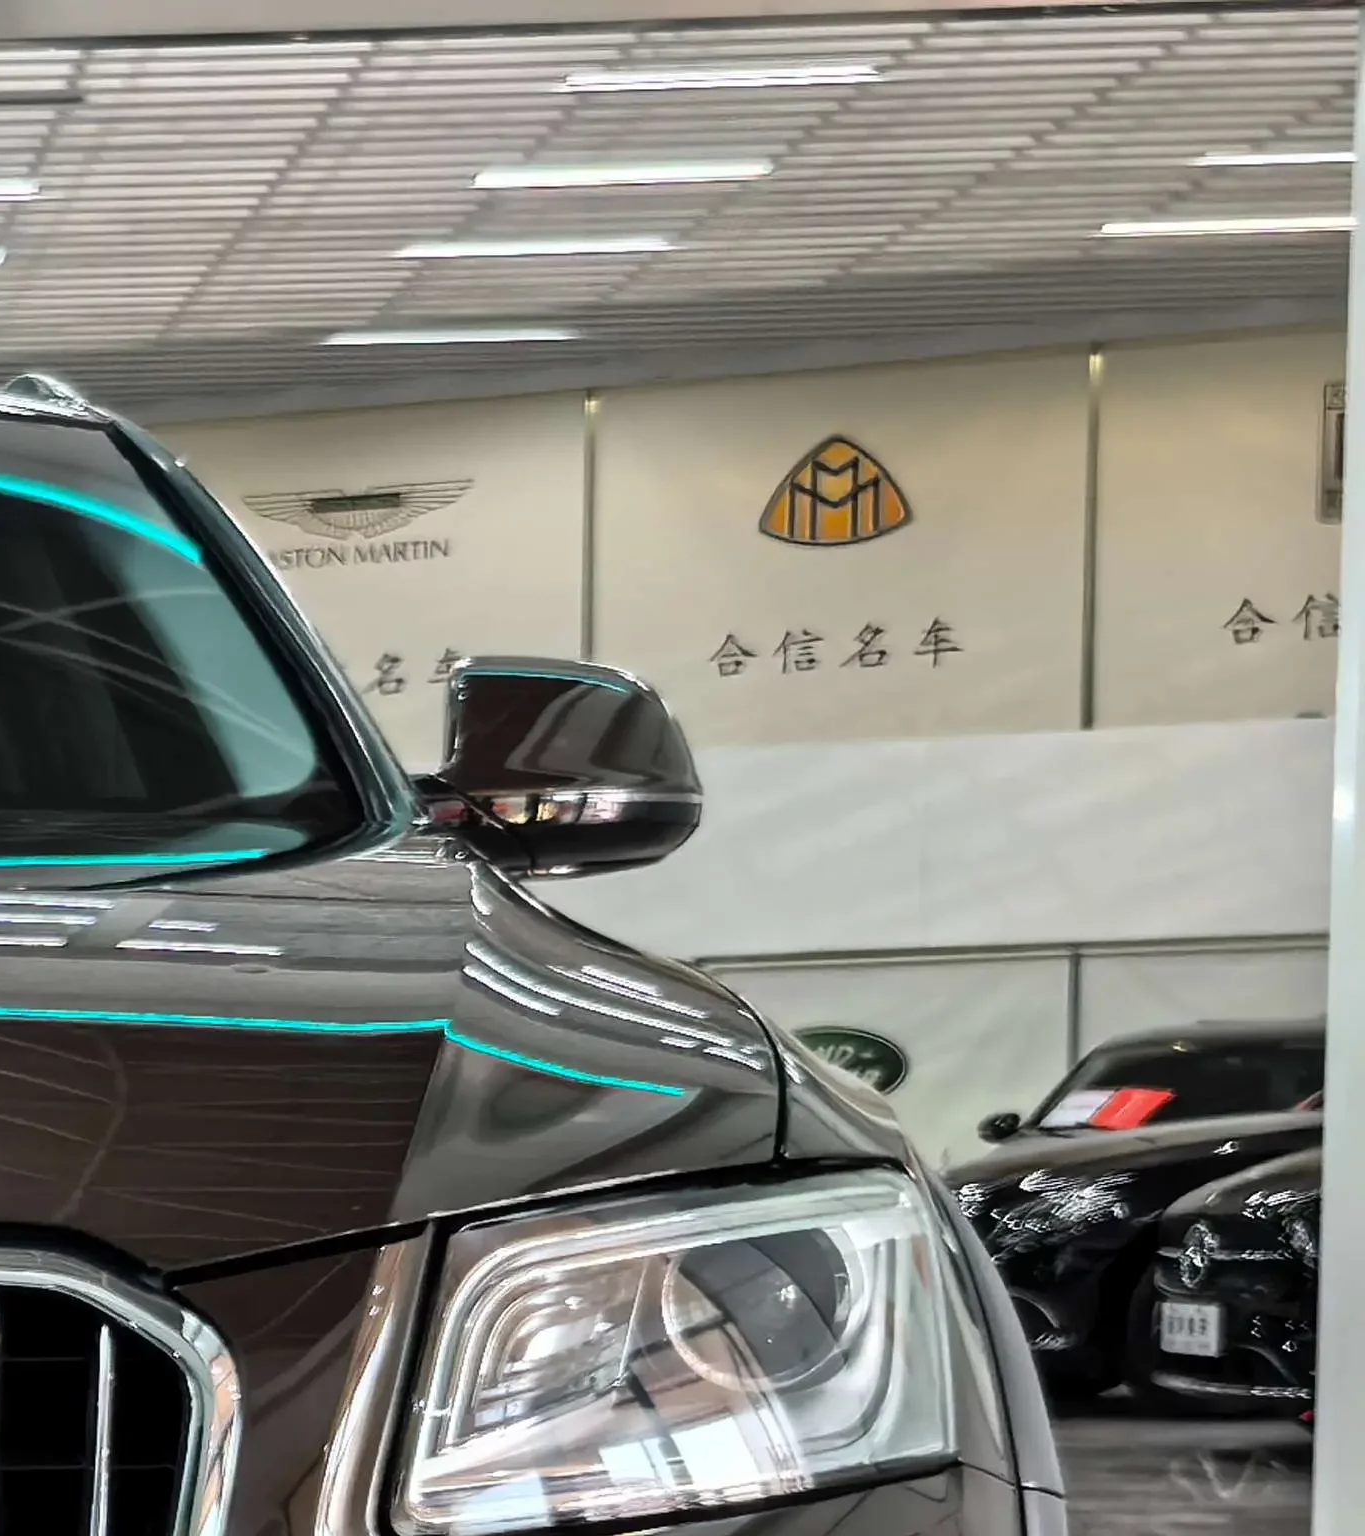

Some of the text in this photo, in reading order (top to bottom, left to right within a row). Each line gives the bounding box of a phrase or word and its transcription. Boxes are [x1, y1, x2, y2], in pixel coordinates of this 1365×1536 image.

[354, 539, 449, 564] MARTIN
[710, 616, 963, 677] 合信名车
